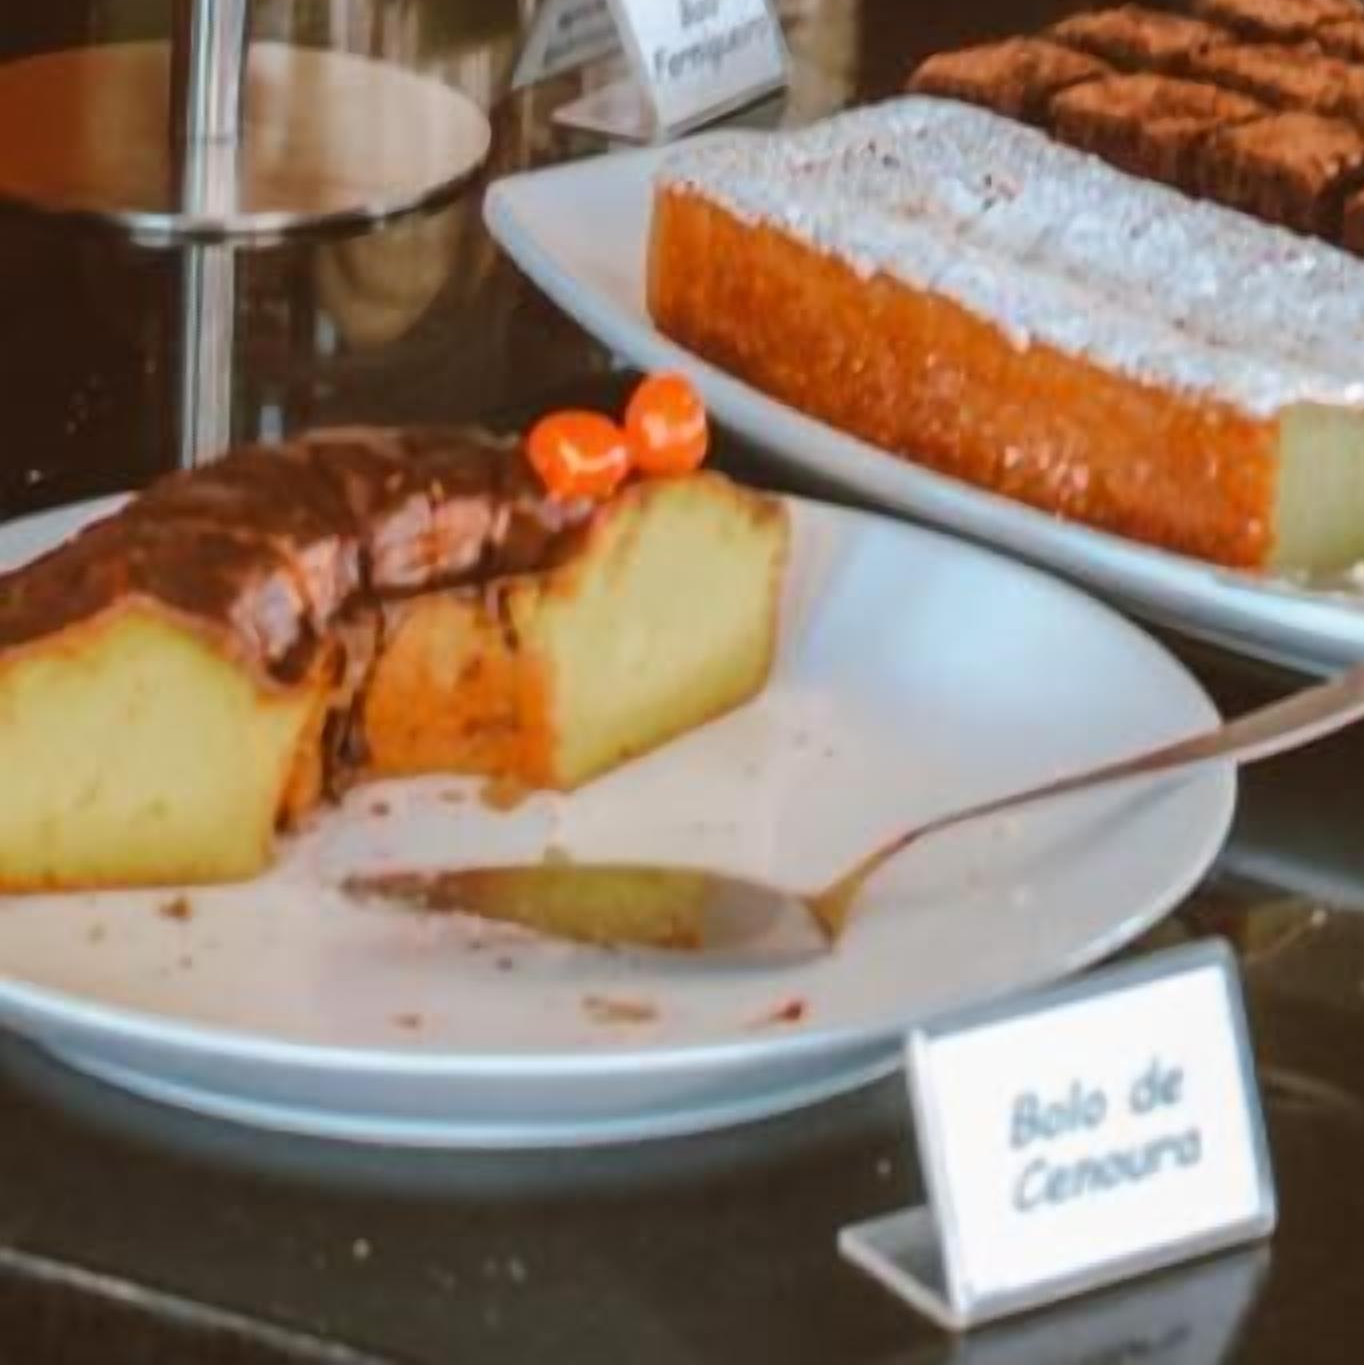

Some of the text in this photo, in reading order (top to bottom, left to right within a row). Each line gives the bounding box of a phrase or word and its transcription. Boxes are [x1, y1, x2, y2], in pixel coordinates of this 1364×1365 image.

[1009, 1055, 1184, 1149] Bolo de
[1011, 1124, 1203, 1211] Cenoura
